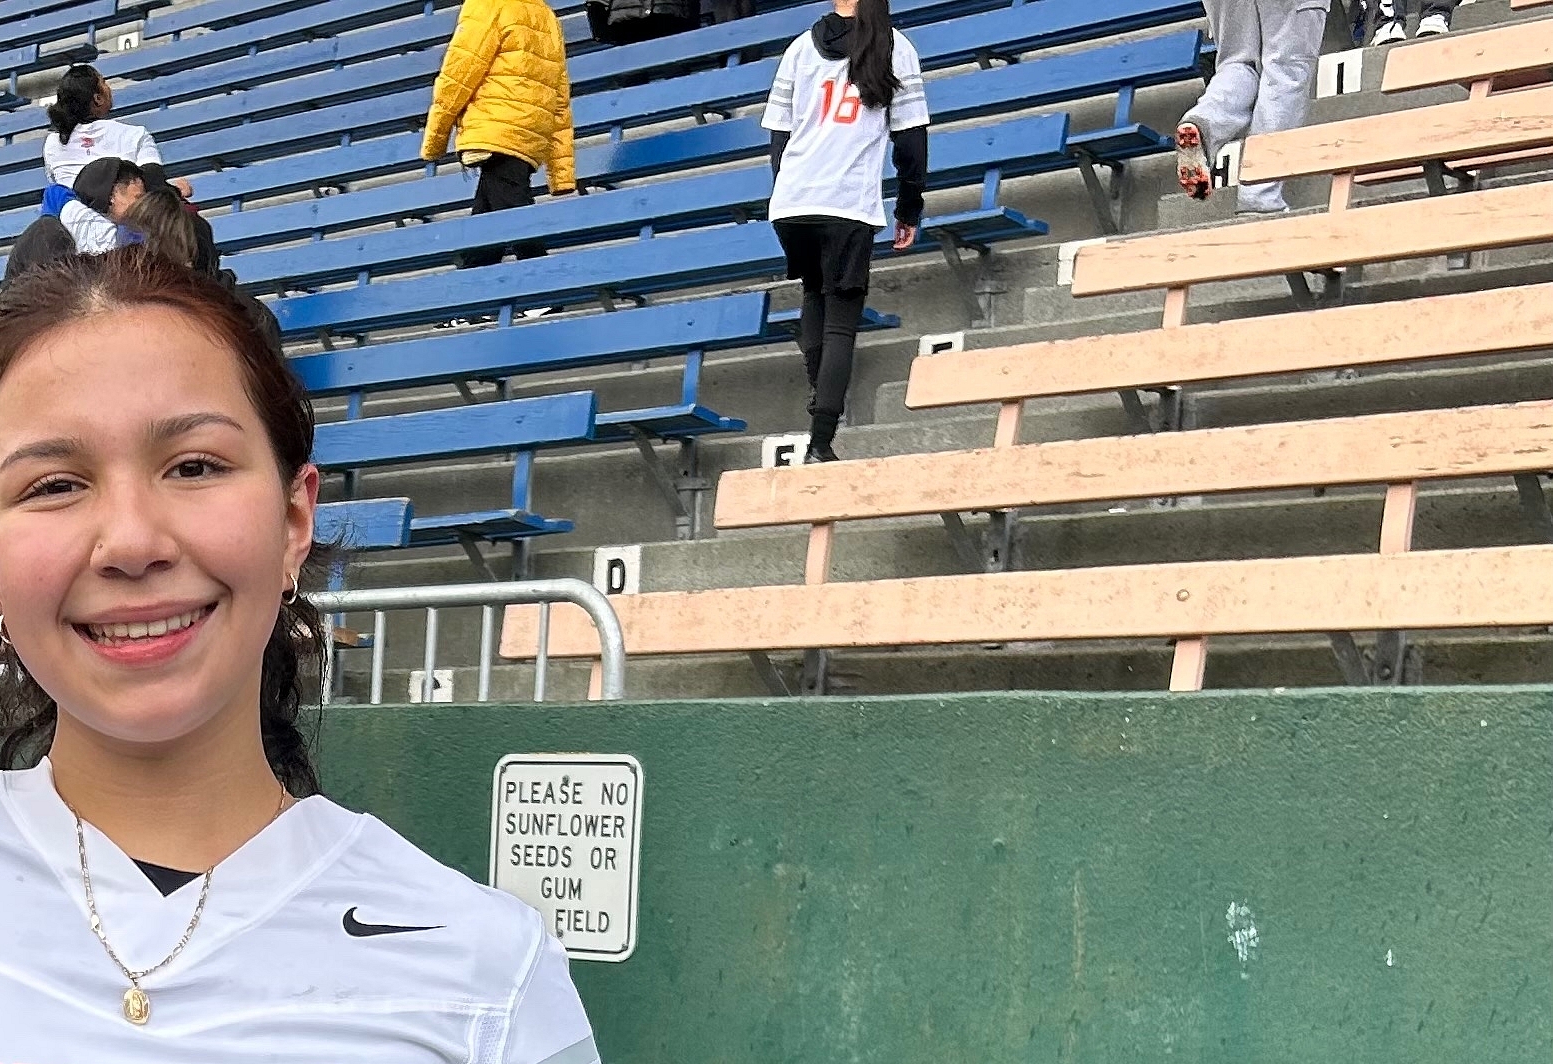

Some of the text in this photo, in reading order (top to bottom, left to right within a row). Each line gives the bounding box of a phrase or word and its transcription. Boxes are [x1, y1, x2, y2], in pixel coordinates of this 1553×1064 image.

[607, 557, 626, 595] D
[504, 781, 629, 806] PLEASE NO
[504, 812, 626, 838] SUNFLOWER
[510, 843, 617, 871] SEEDS OR
[540, 876, 583, 901] GUM
[555, 908, 610, 934] FIELD
